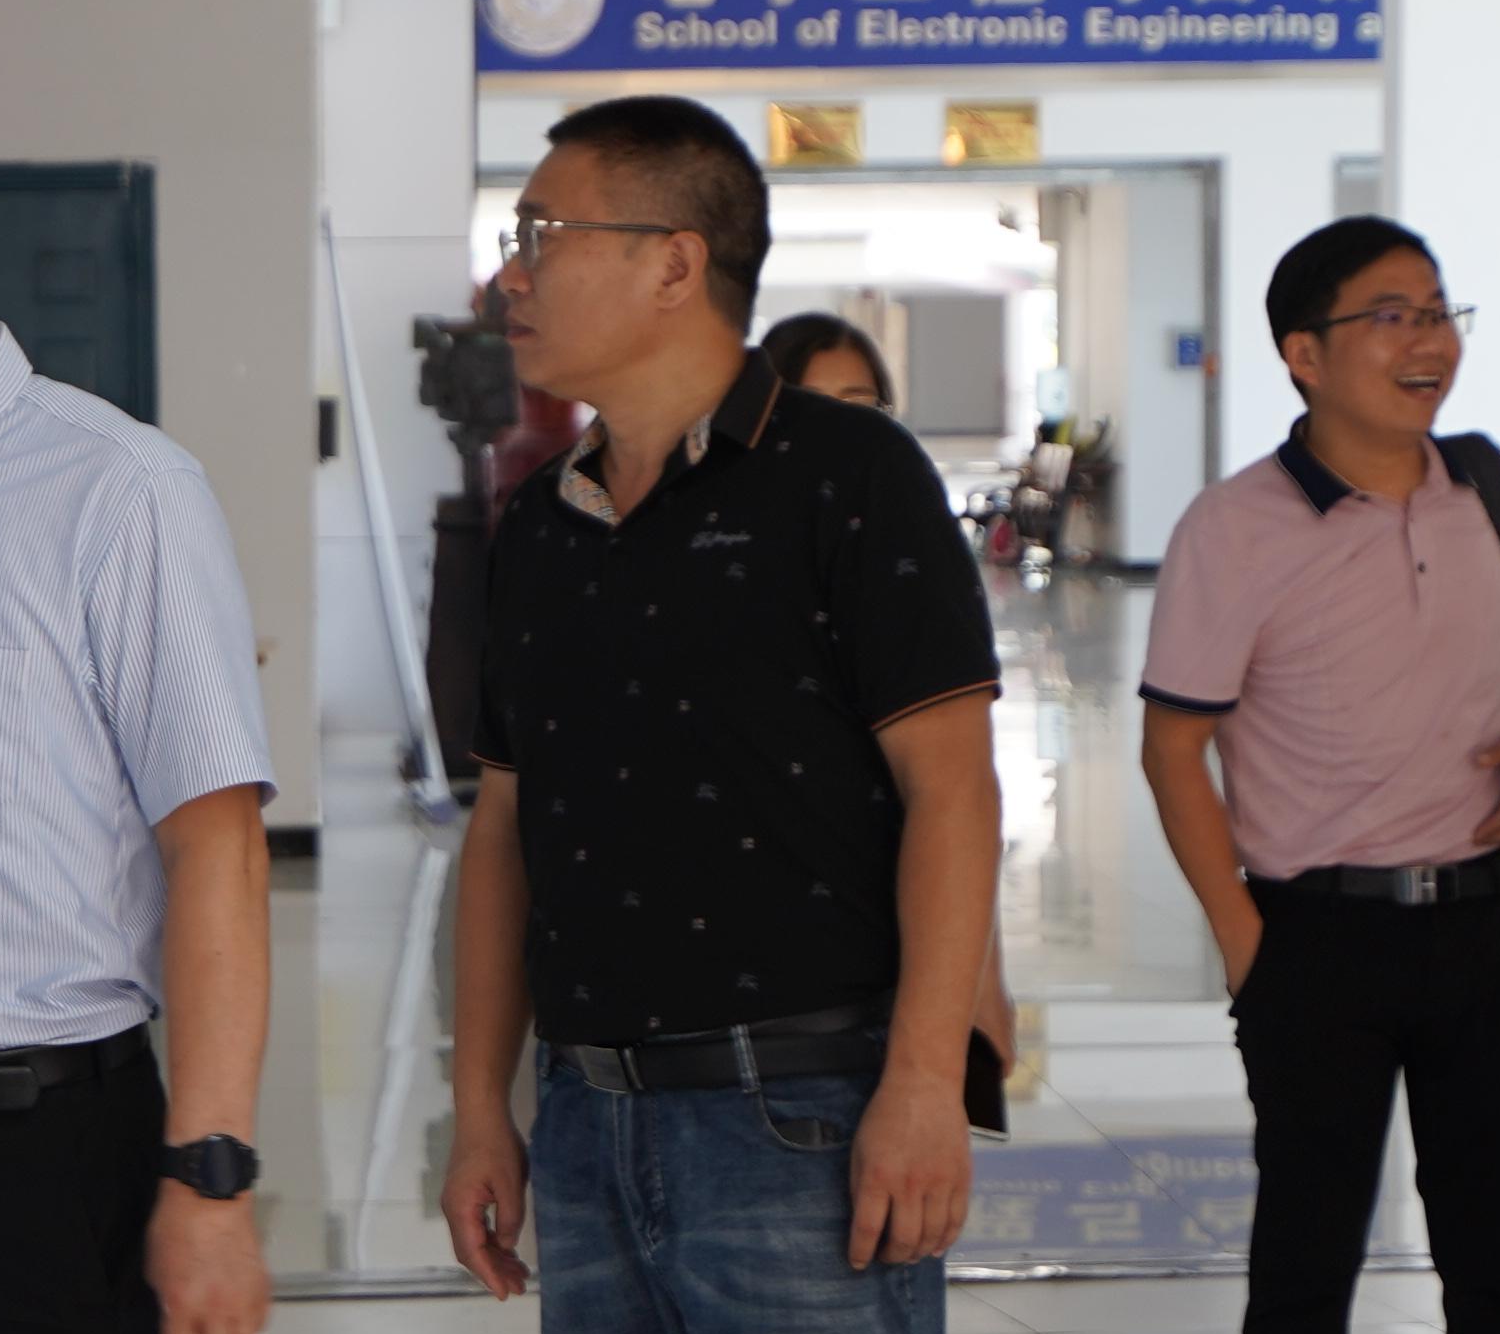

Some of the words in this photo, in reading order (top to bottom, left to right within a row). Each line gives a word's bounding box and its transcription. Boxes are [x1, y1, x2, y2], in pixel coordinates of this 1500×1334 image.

[635, 10, 779, 48] School
[796, 8, 841, 47] of
[857, 7, 1068, 47] Electronic
[1084, 3, 1338, 51] Engineering
